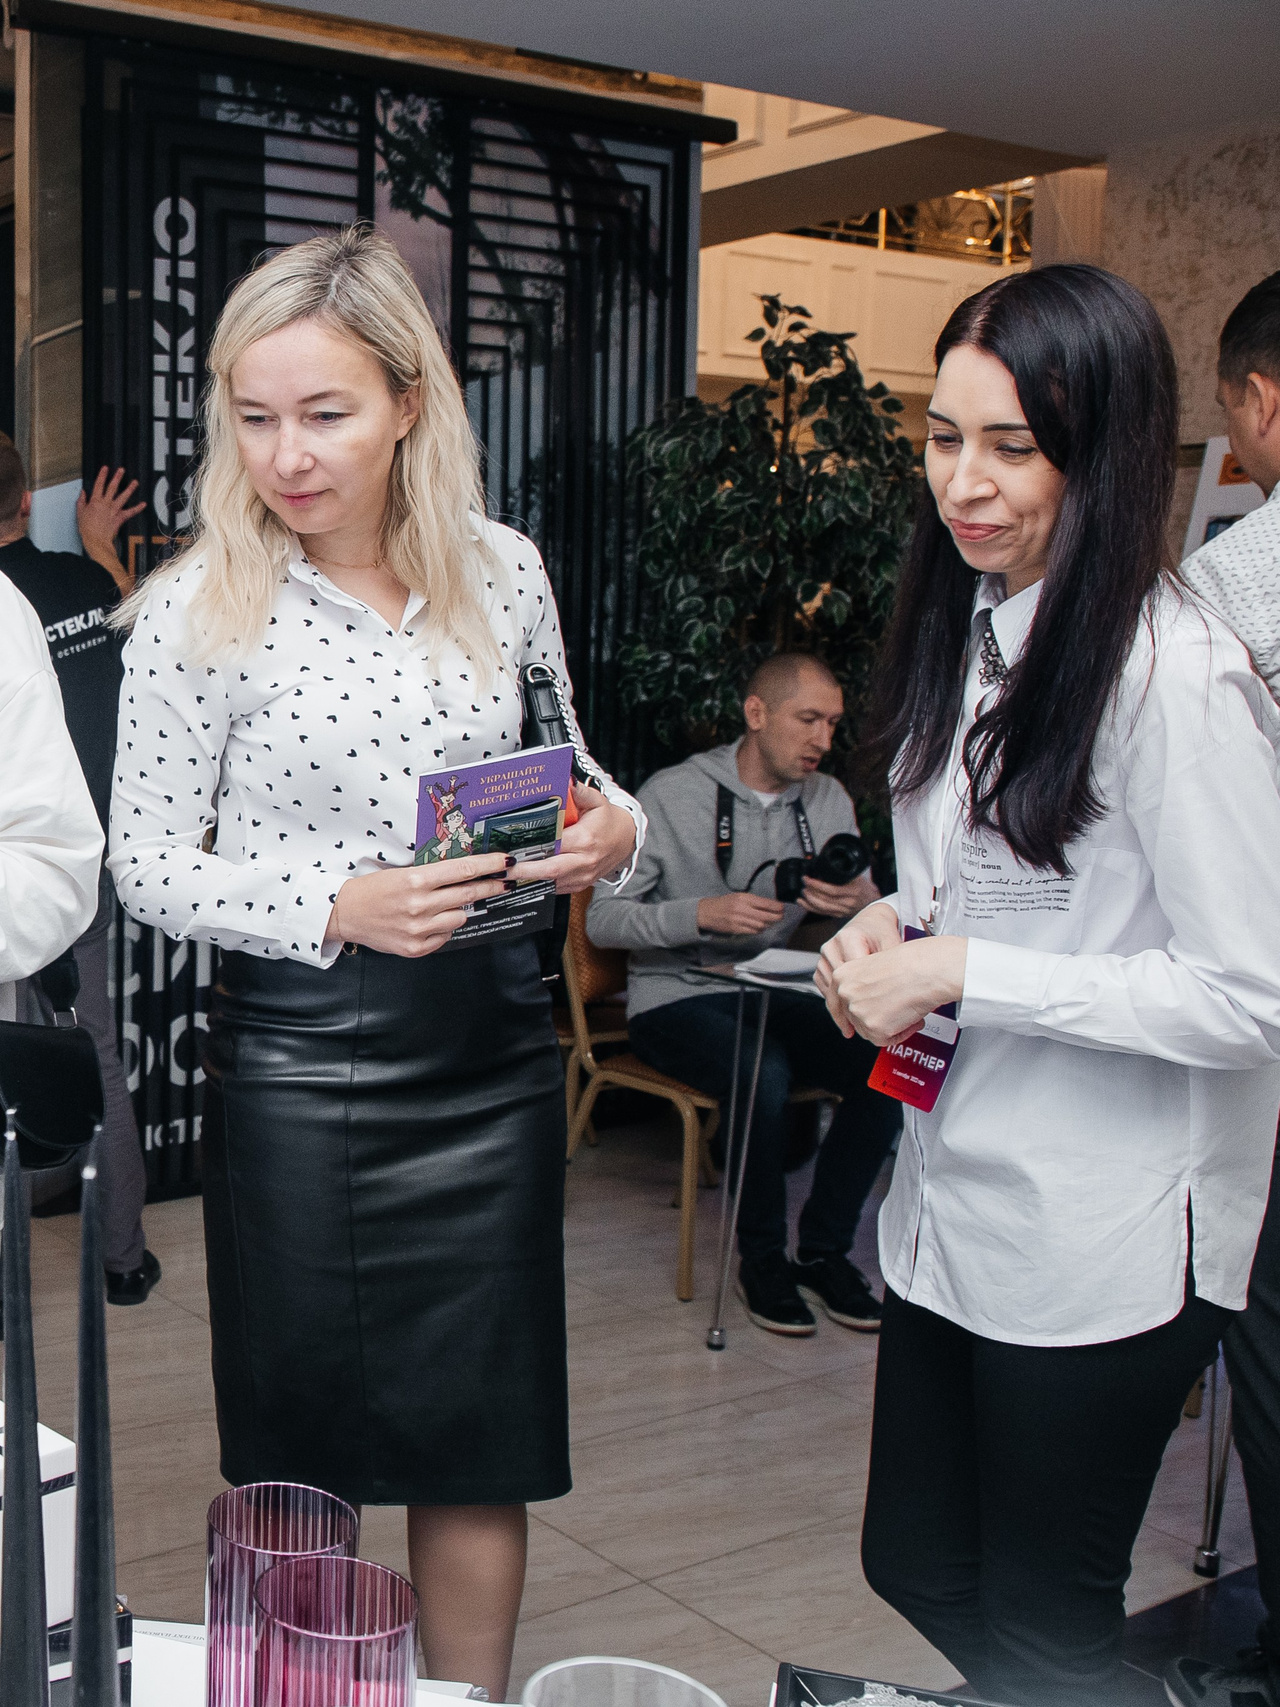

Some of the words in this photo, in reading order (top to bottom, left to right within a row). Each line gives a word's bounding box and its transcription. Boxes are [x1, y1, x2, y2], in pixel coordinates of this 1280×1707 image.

[153, 196, 196, 529] СТЕКЛО
[480, 764, 546, 785] УКРАШАЙТЕ
[484, 780, 513, 795] СВОЙ
[515, 777, 539, 790] ДОМ
[469, 793, 511, 808] ВМЕСТЕ
[512, 791, 520, 799] С
[521, 784, 552, 797] НАМИ
[961, 841, 988, 858] nspire
[981, 863, 1002, 871] noun
